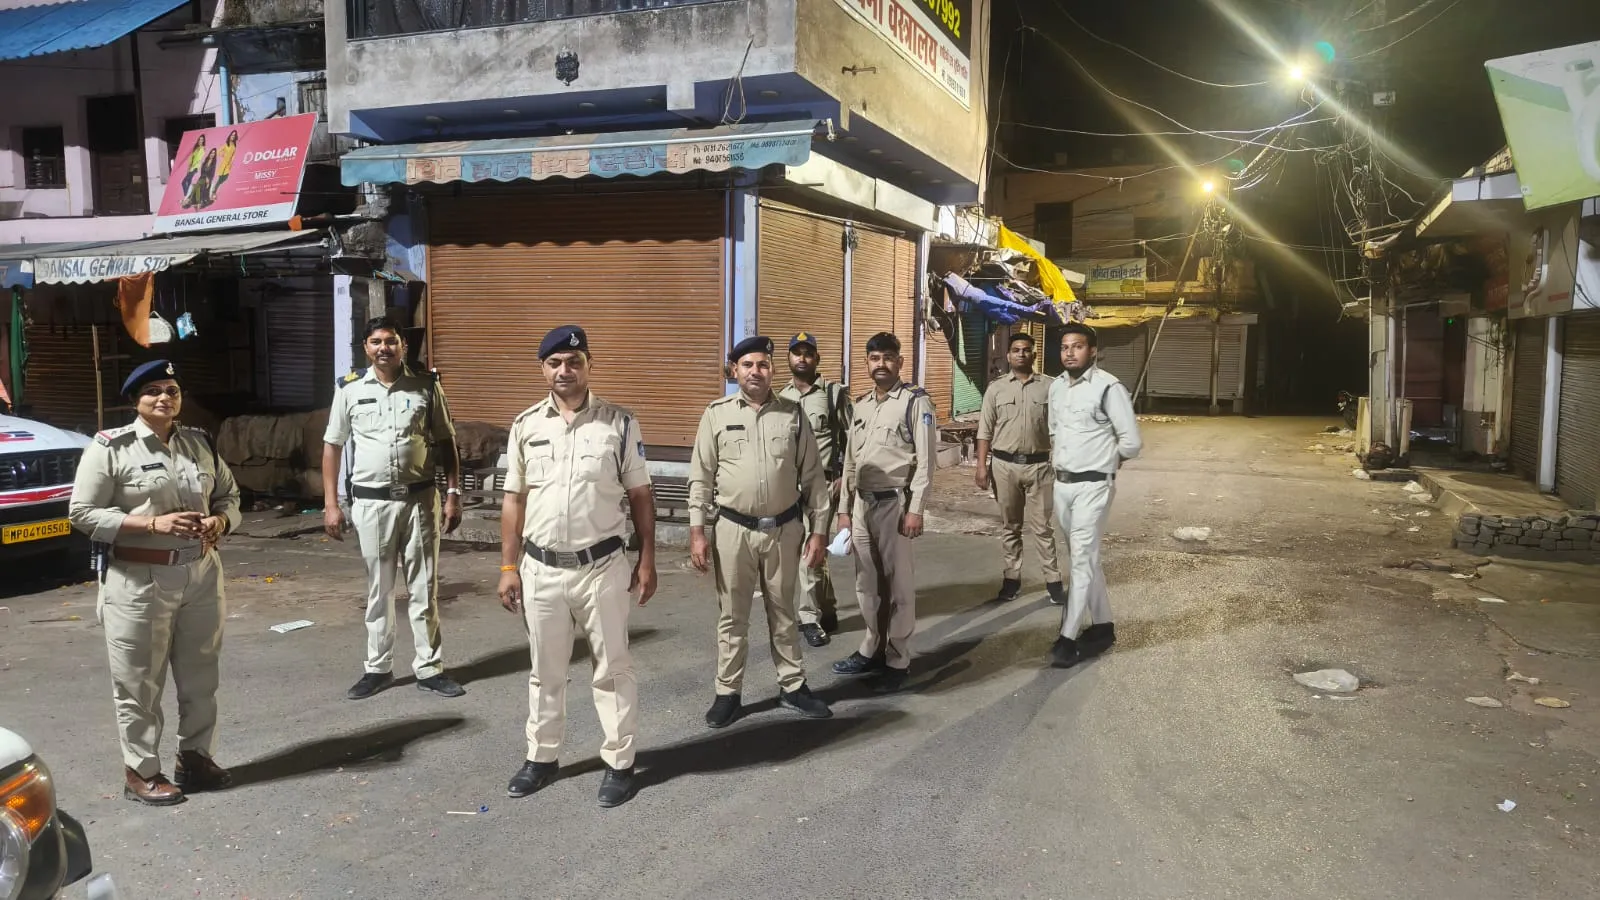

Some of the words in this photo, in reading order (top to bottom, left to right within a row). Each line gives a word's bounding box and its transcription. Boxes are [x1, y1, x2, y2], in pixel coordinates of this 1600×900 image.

[254, 146, 298, 162] DOLLAR
[254, 170, 277, 180] MISSY
[175, 217, 204, 227] BANSAL
[206, 213, 240, 224] GENERAL
[243, 210, 269, 220] STORE
